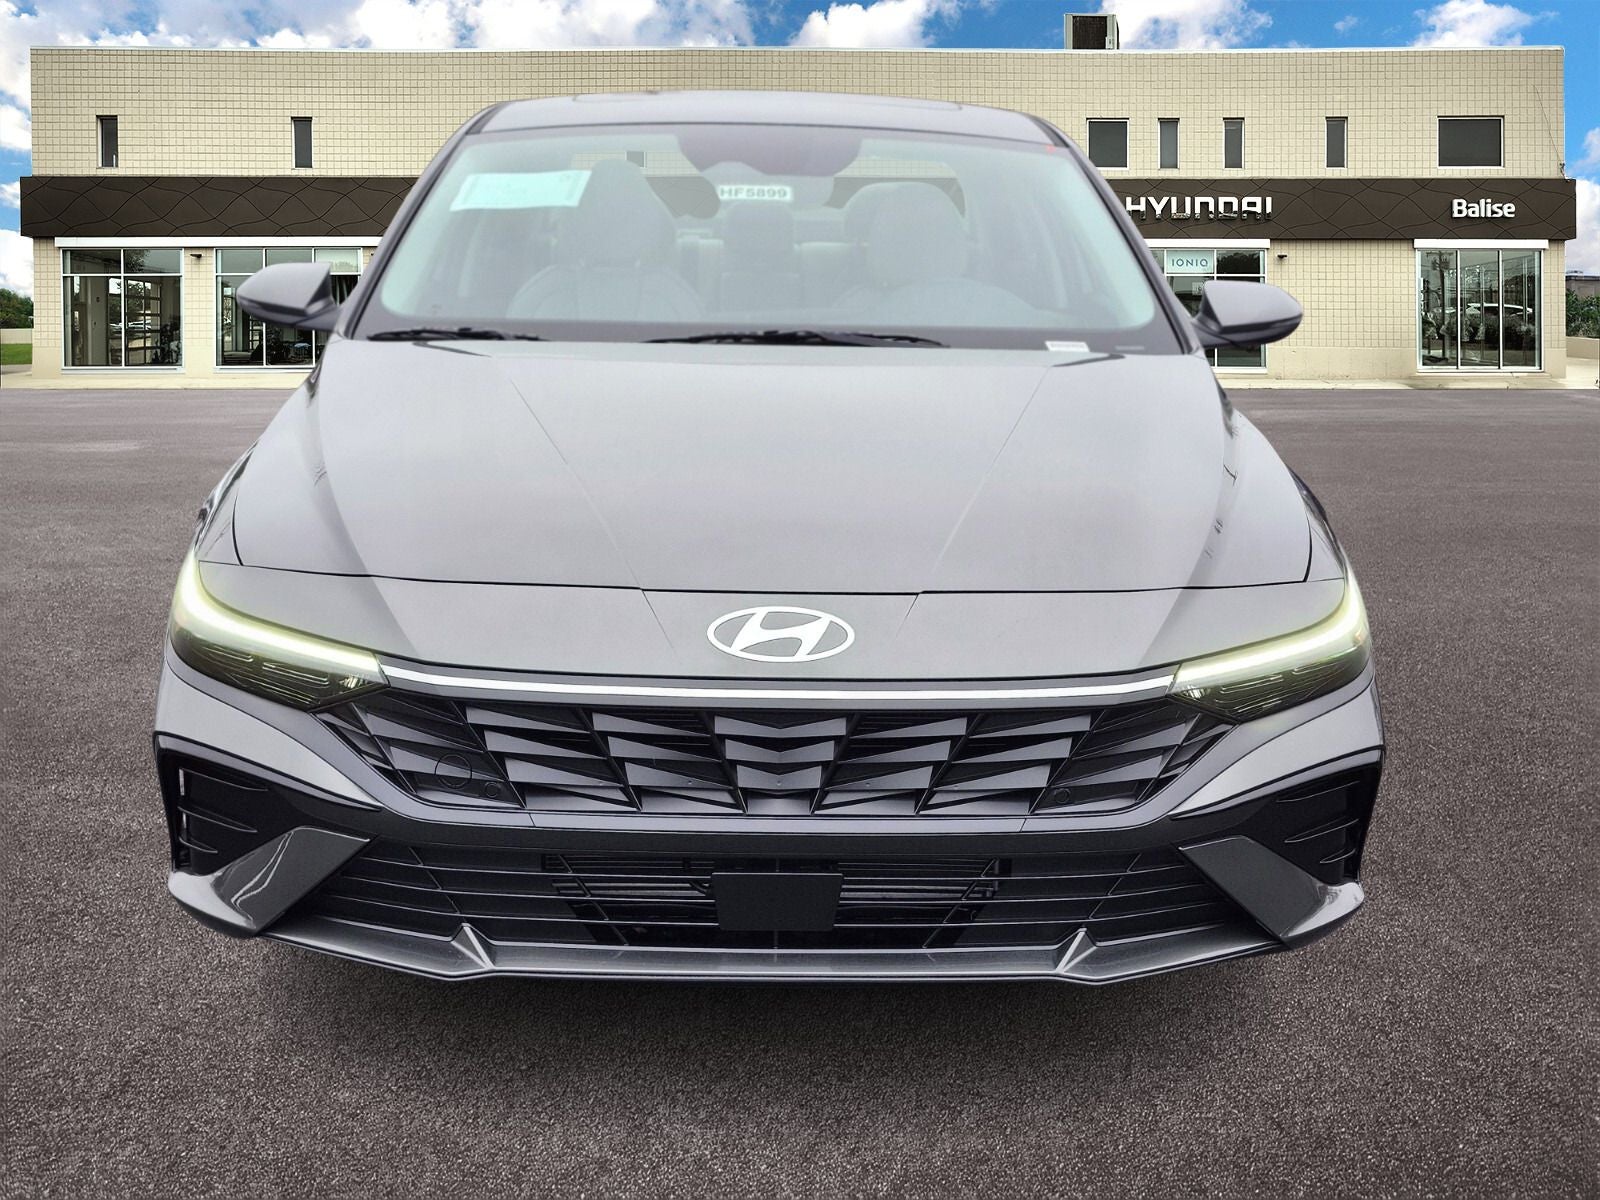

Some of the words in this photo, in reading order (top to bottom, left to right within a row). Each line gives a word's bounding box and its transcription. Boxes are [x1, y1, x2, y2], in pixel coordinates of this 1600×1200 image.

[719, 186, 788, 198] HF5899
[1125, 196, 1273, 220] HYUNDAI
[1451, 198, 1516, 218] Balise
[1171, 258, 1209, 268] IONIQ
